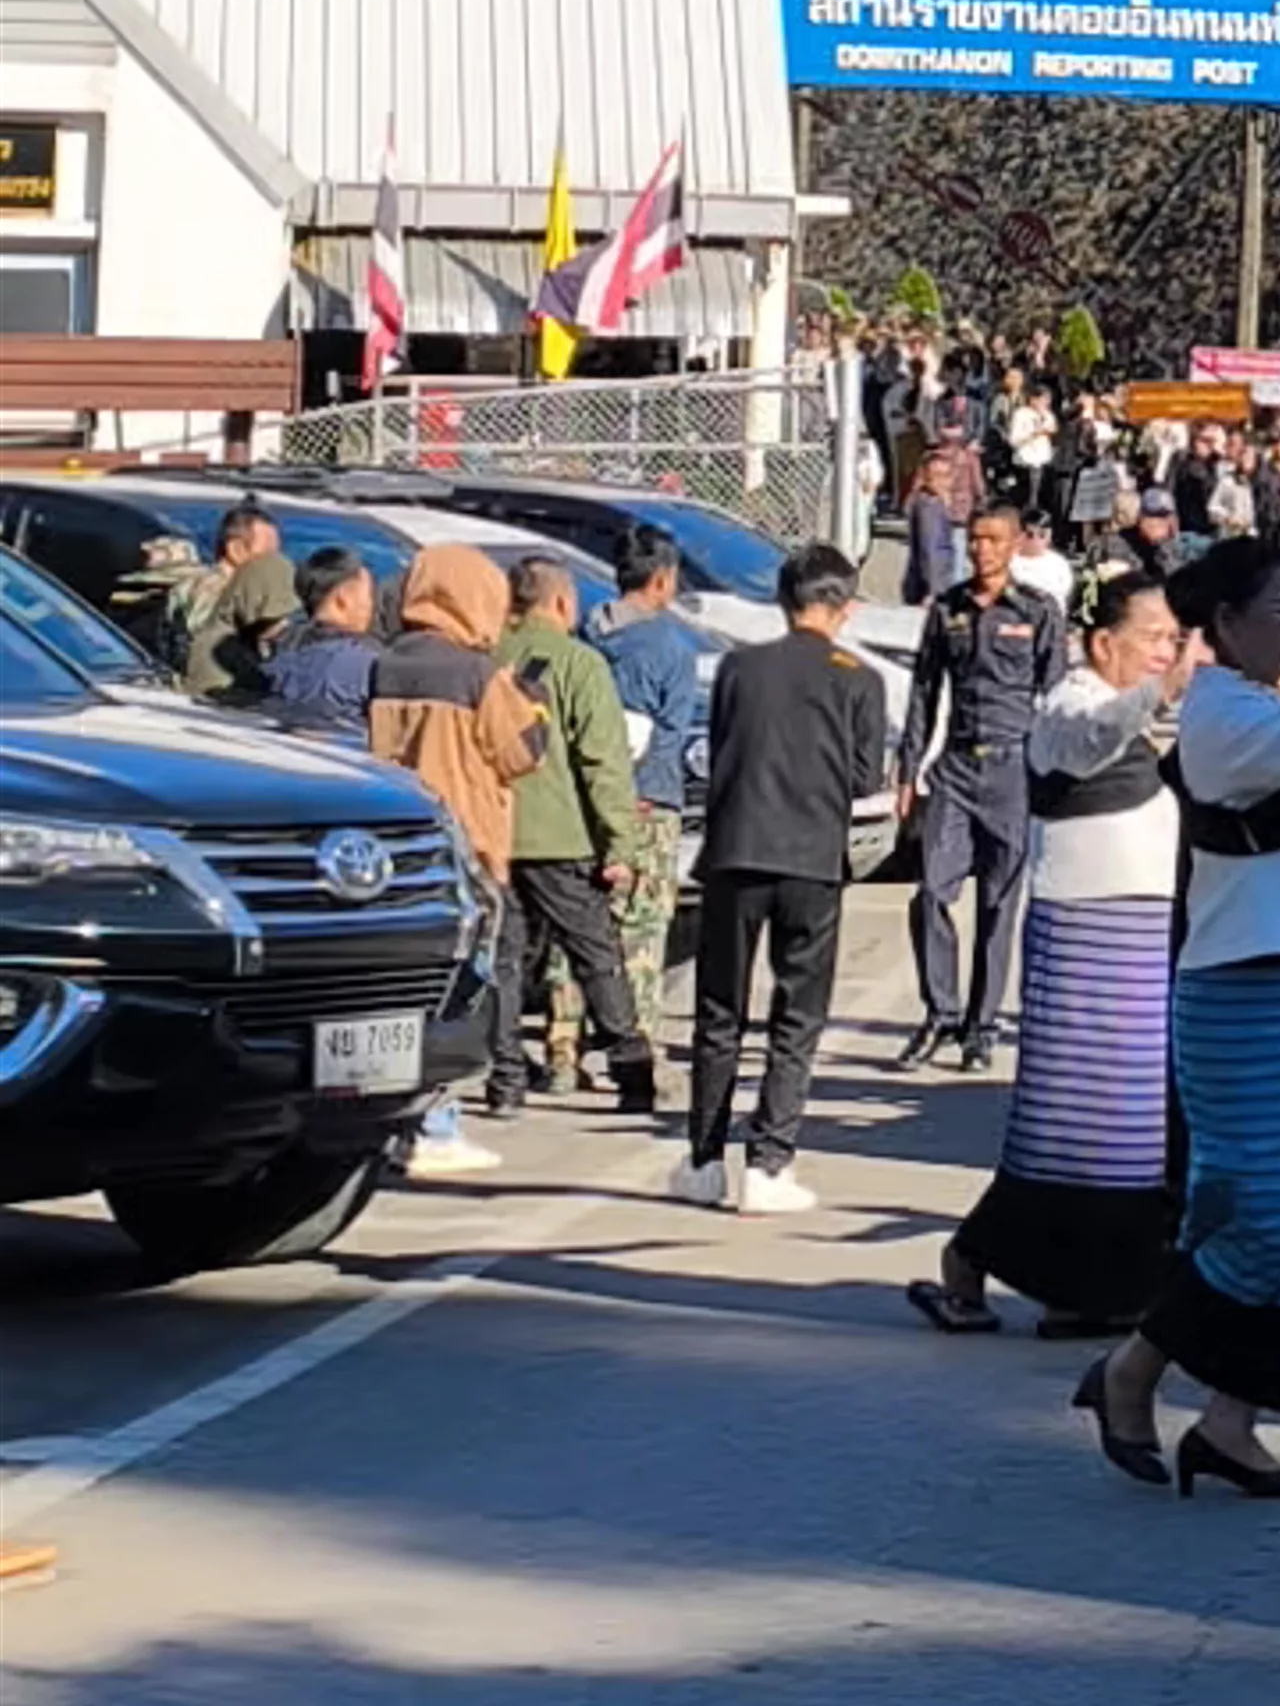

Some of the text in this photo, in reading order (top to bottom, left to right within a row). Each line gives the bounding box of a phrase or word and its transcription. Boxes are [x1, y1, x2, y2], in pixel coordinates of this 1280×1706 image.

[1032, 50, 1174, 82] REPORTING
[1192, 57, 1259, 86] POST
[367, 1022, 417, 1056] 7059
